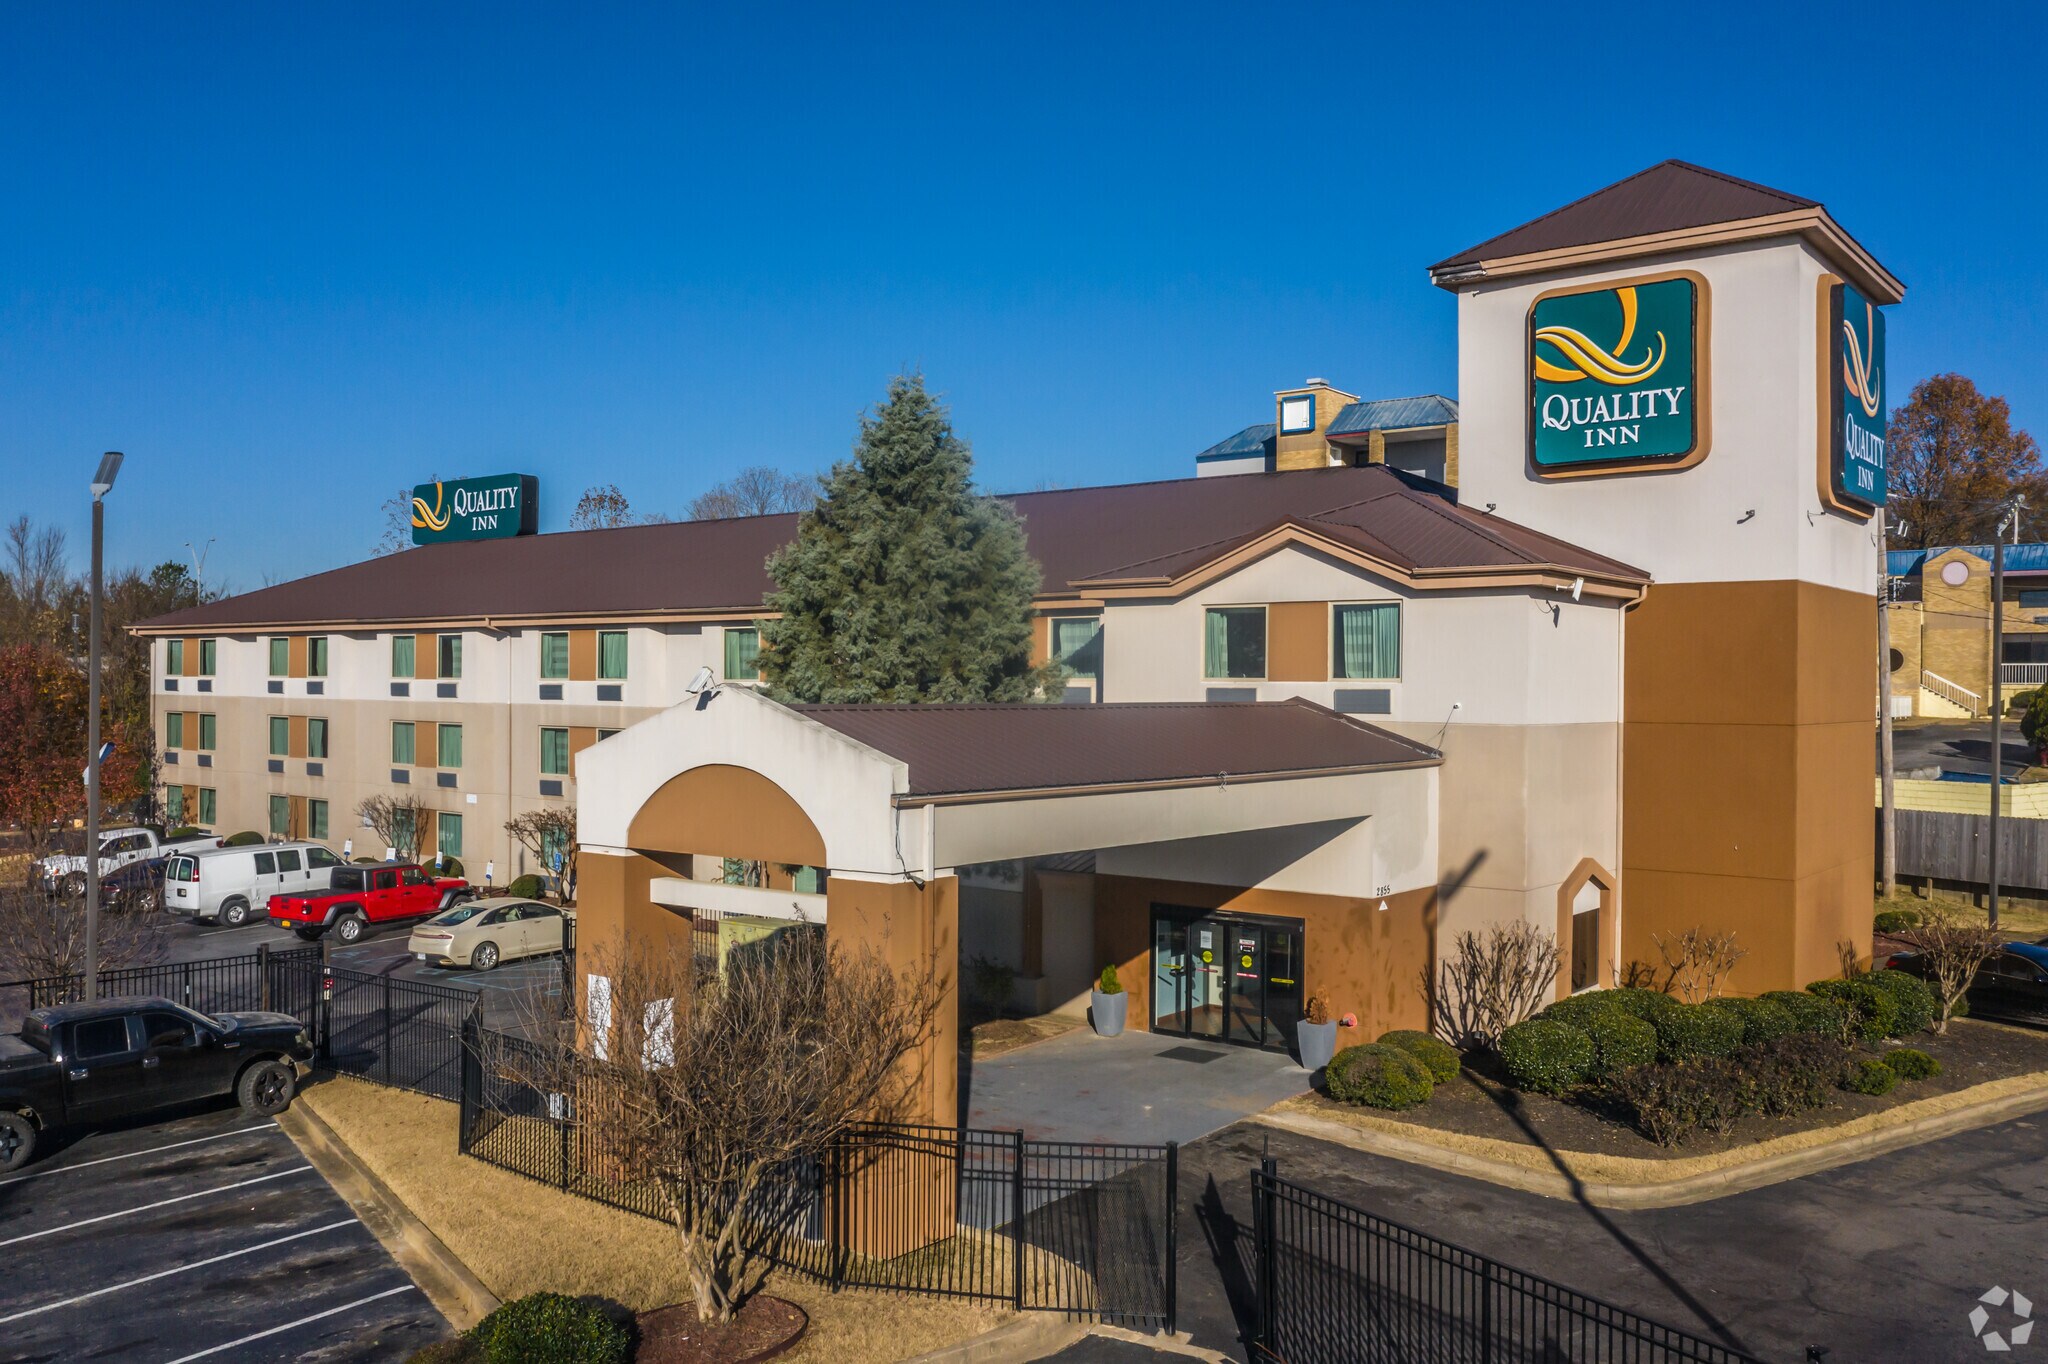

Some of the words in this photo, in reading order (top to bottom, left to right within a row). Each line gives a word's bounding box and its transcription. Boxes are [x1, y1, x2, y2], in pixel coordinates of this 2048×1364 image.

[1542, 386, 1686, 431] QUALITY
[1583, 424, 1641, 448] INN
[1845, 412, 1885, 469] QUALITY
[1857, 465, 1874, 492] INN
[454, 486, 518, 517] QUALITY
[471, 514, 498, 531] INN
